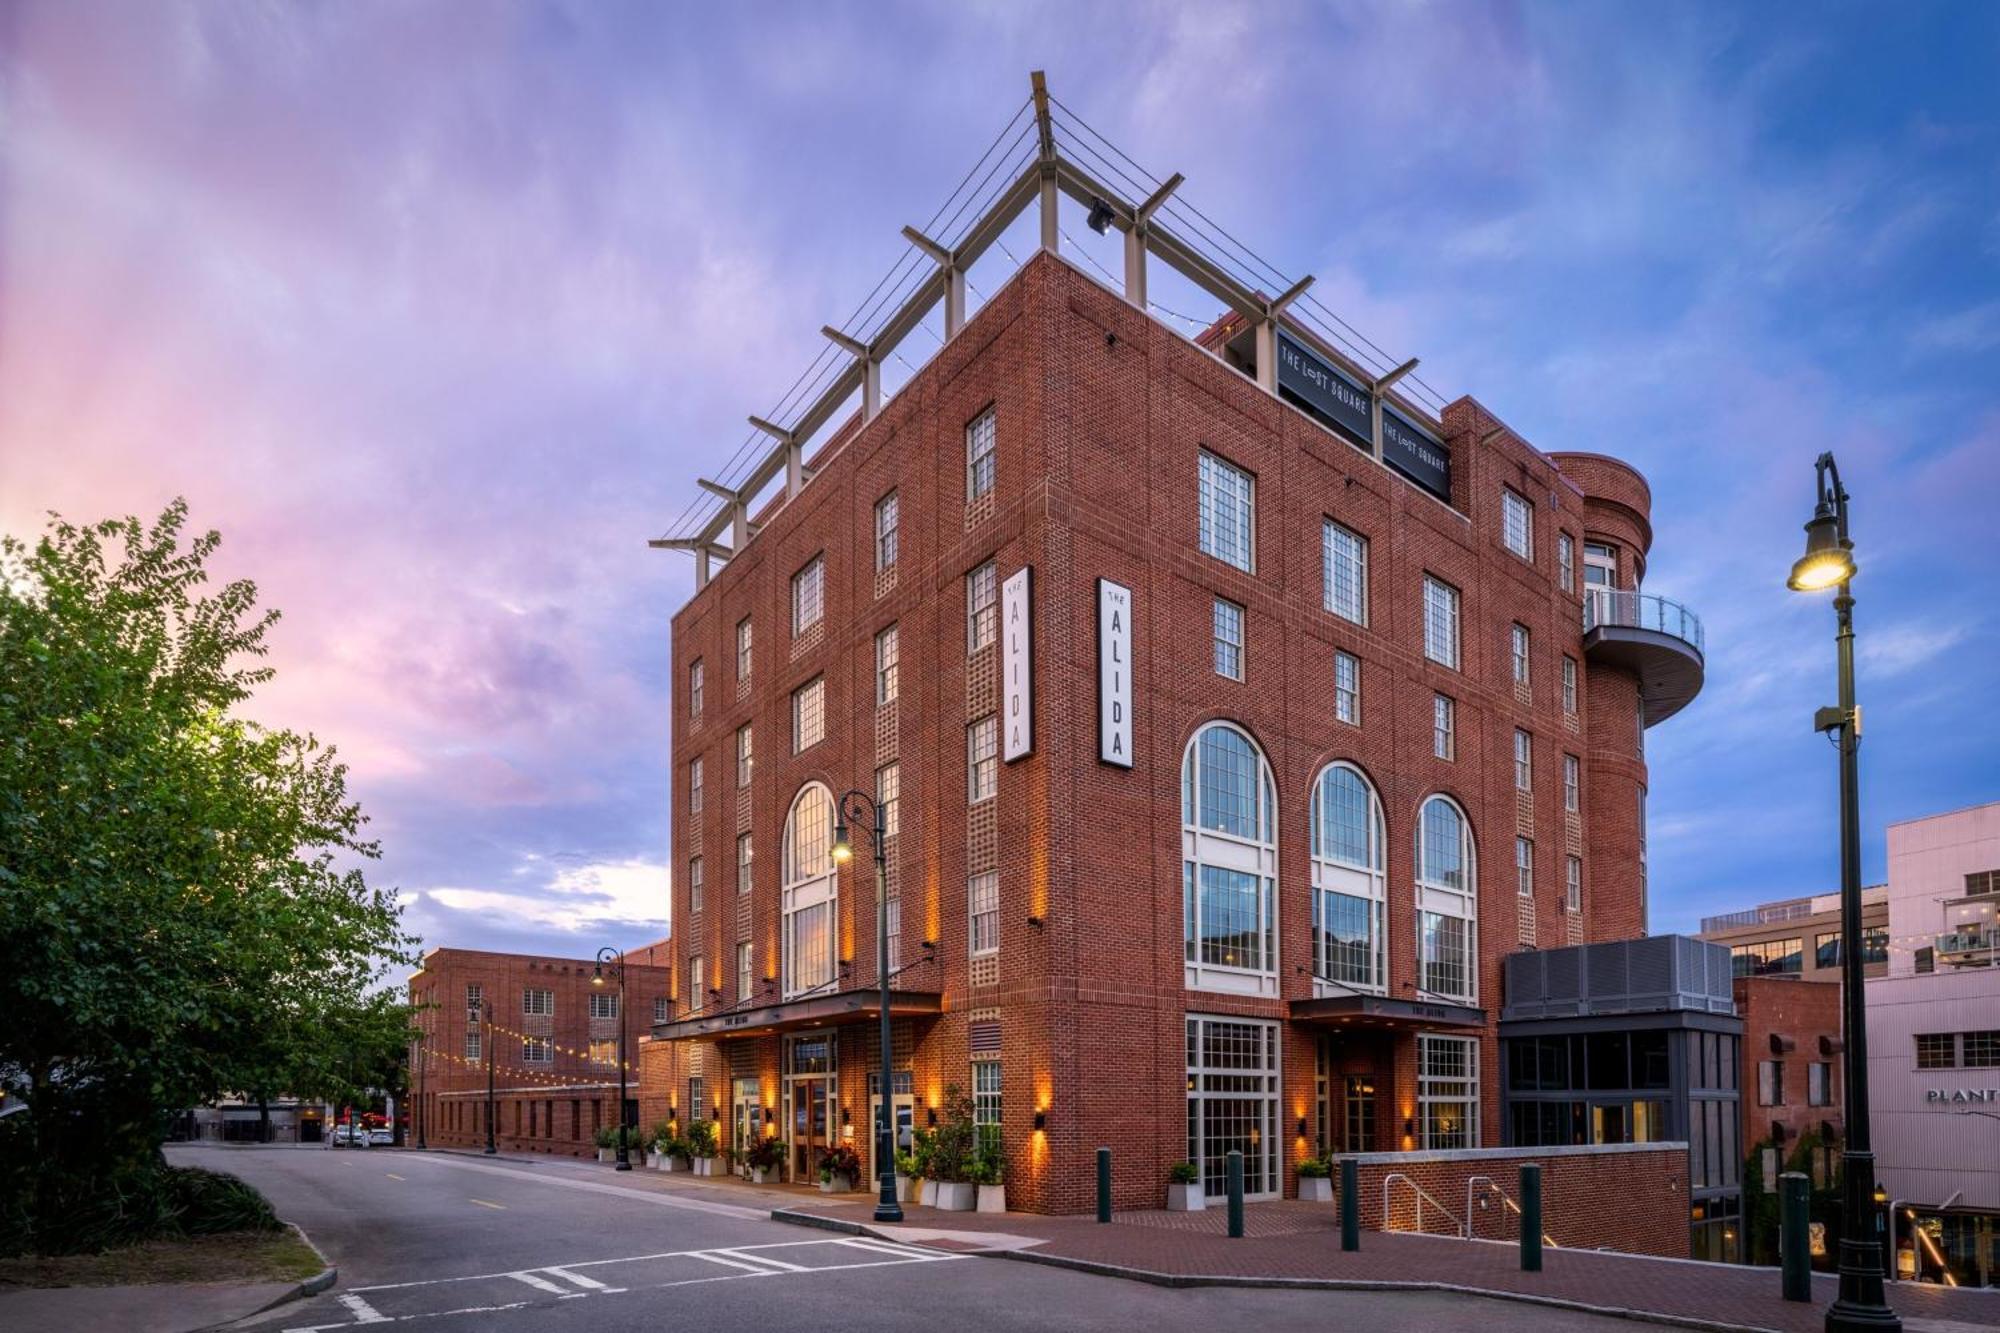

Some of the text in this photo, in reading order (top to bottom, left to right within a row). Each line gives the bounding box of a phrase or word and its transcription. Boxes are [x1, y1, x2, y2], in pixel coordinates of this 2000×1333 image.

[1282, 346, 1299, 371] THE
[1331, 381, 1367, 415] SQUARE
[1384, 422, 1396, 440] THE
[1419, 447, 1444, 472] SQUARE
[1007, 580, 1022, 595] THE
[1108, 591, 1124, 605] THE
[1011, 601, 1020, 748] ALIDA
[1112, 610, 1122, 755] ALIDA
[1928, 1089, 1998, 1103] PLANT
